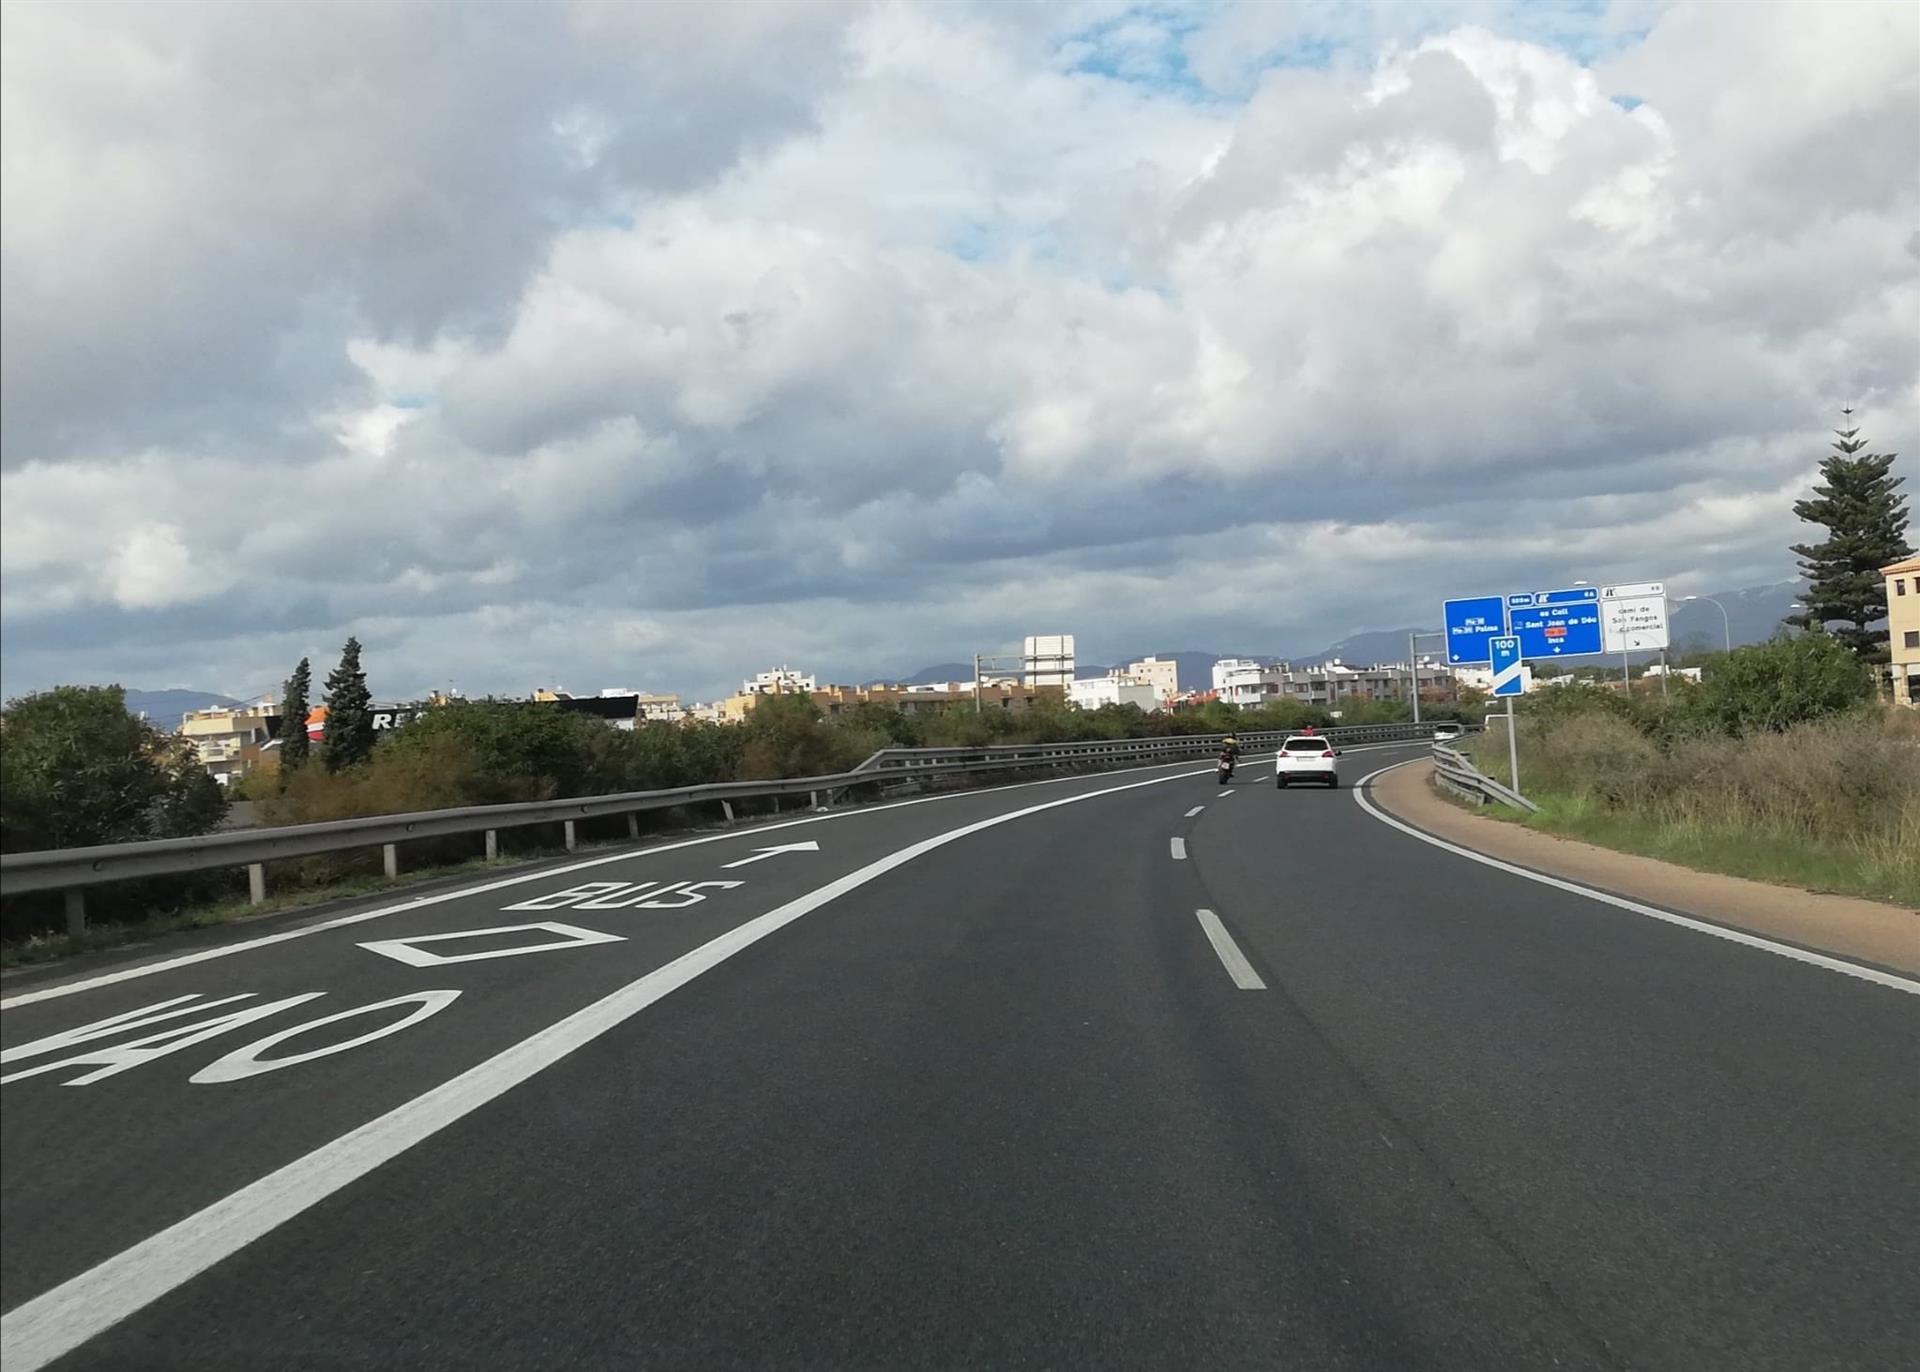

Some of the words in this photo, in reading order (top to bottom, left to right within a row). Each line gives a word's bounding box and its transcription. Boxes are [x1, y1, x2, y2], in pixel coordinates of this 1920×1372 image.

[1525, 621, 1544, 629] Sant
[1547, 619, 1566, 627] Joan
[1495, 640, 1515, 650] 100
[500, 881, 746, 910] BUS
